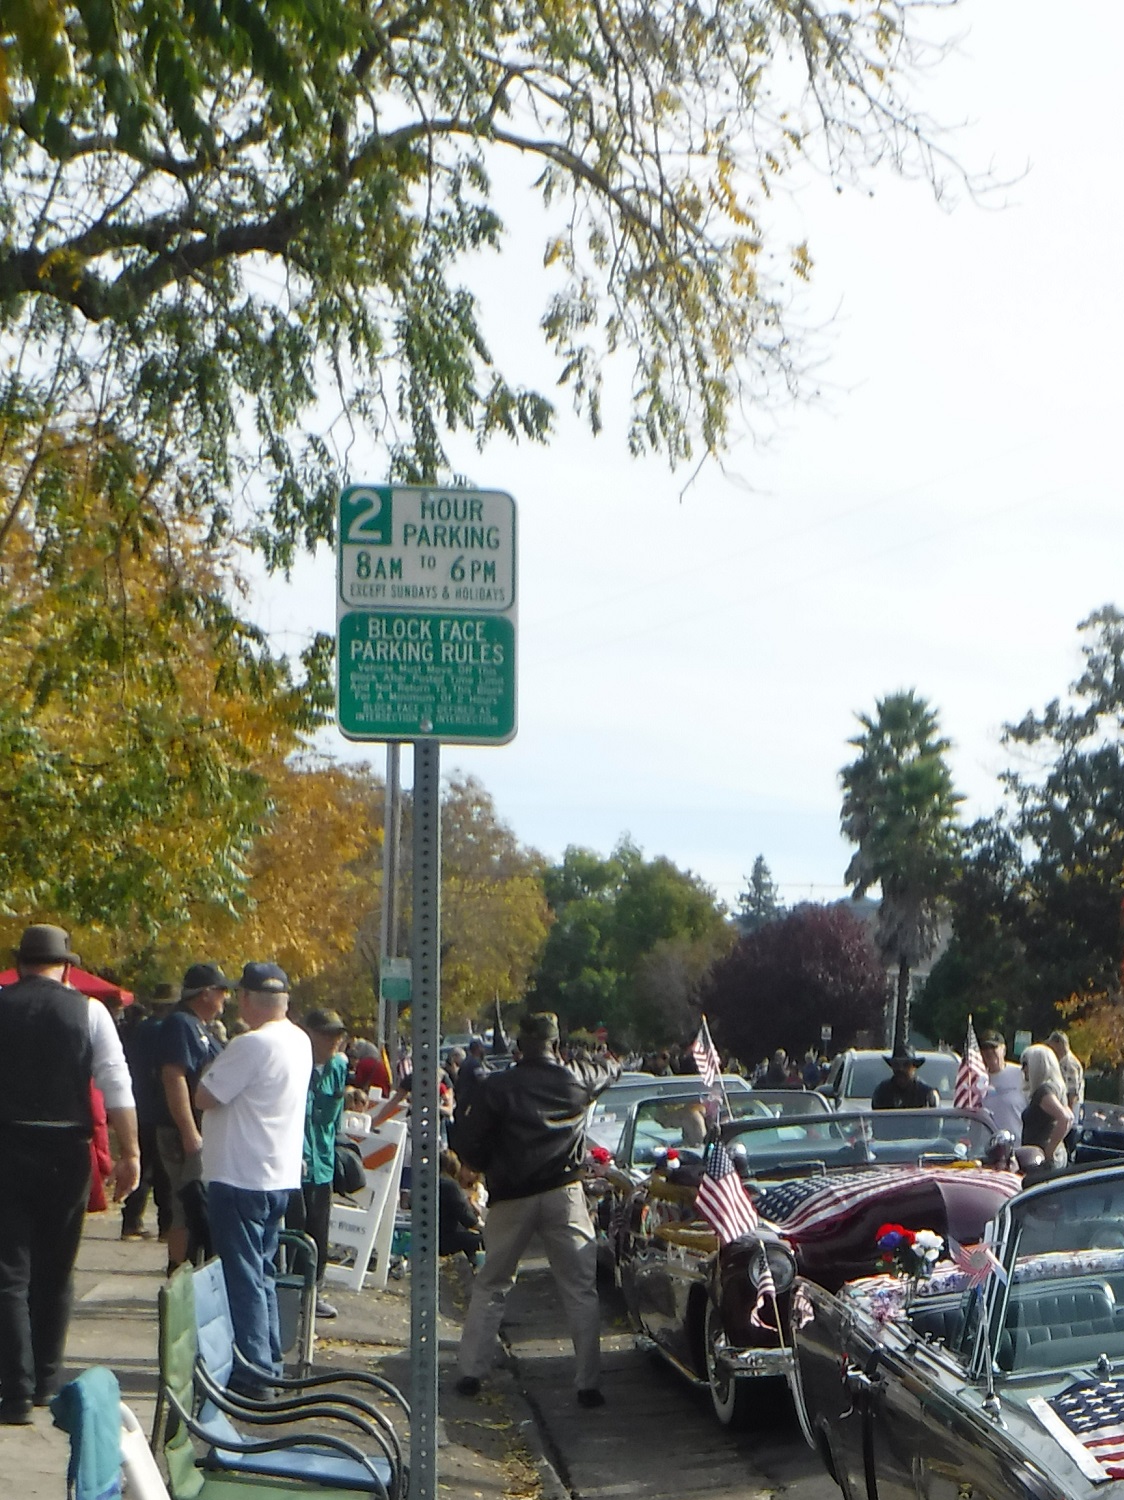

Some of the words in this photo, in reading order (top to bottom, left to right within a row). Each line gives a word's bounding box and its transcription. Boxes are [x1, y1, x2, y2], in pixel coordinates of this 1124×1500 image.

[348, 488, 382, 542] 2
[420, 497, 483, 522] HOUR
[403, 523, 500, 549] PARKING
[420, 555, 437, 570] TO
[350, 583, 386, 598] EXCEPT
[391, 584, 437, 599] SUNDAYS
[441, 586, 450, 600] &
[455, 586, 505, 601] HOLIDAYS
[368, 617, 432, 641] BLOCK
[439, 620, 487, 643] FACE
[350, 639, 434, 663] PARKING
[441, 643, 505, 665] RULES
